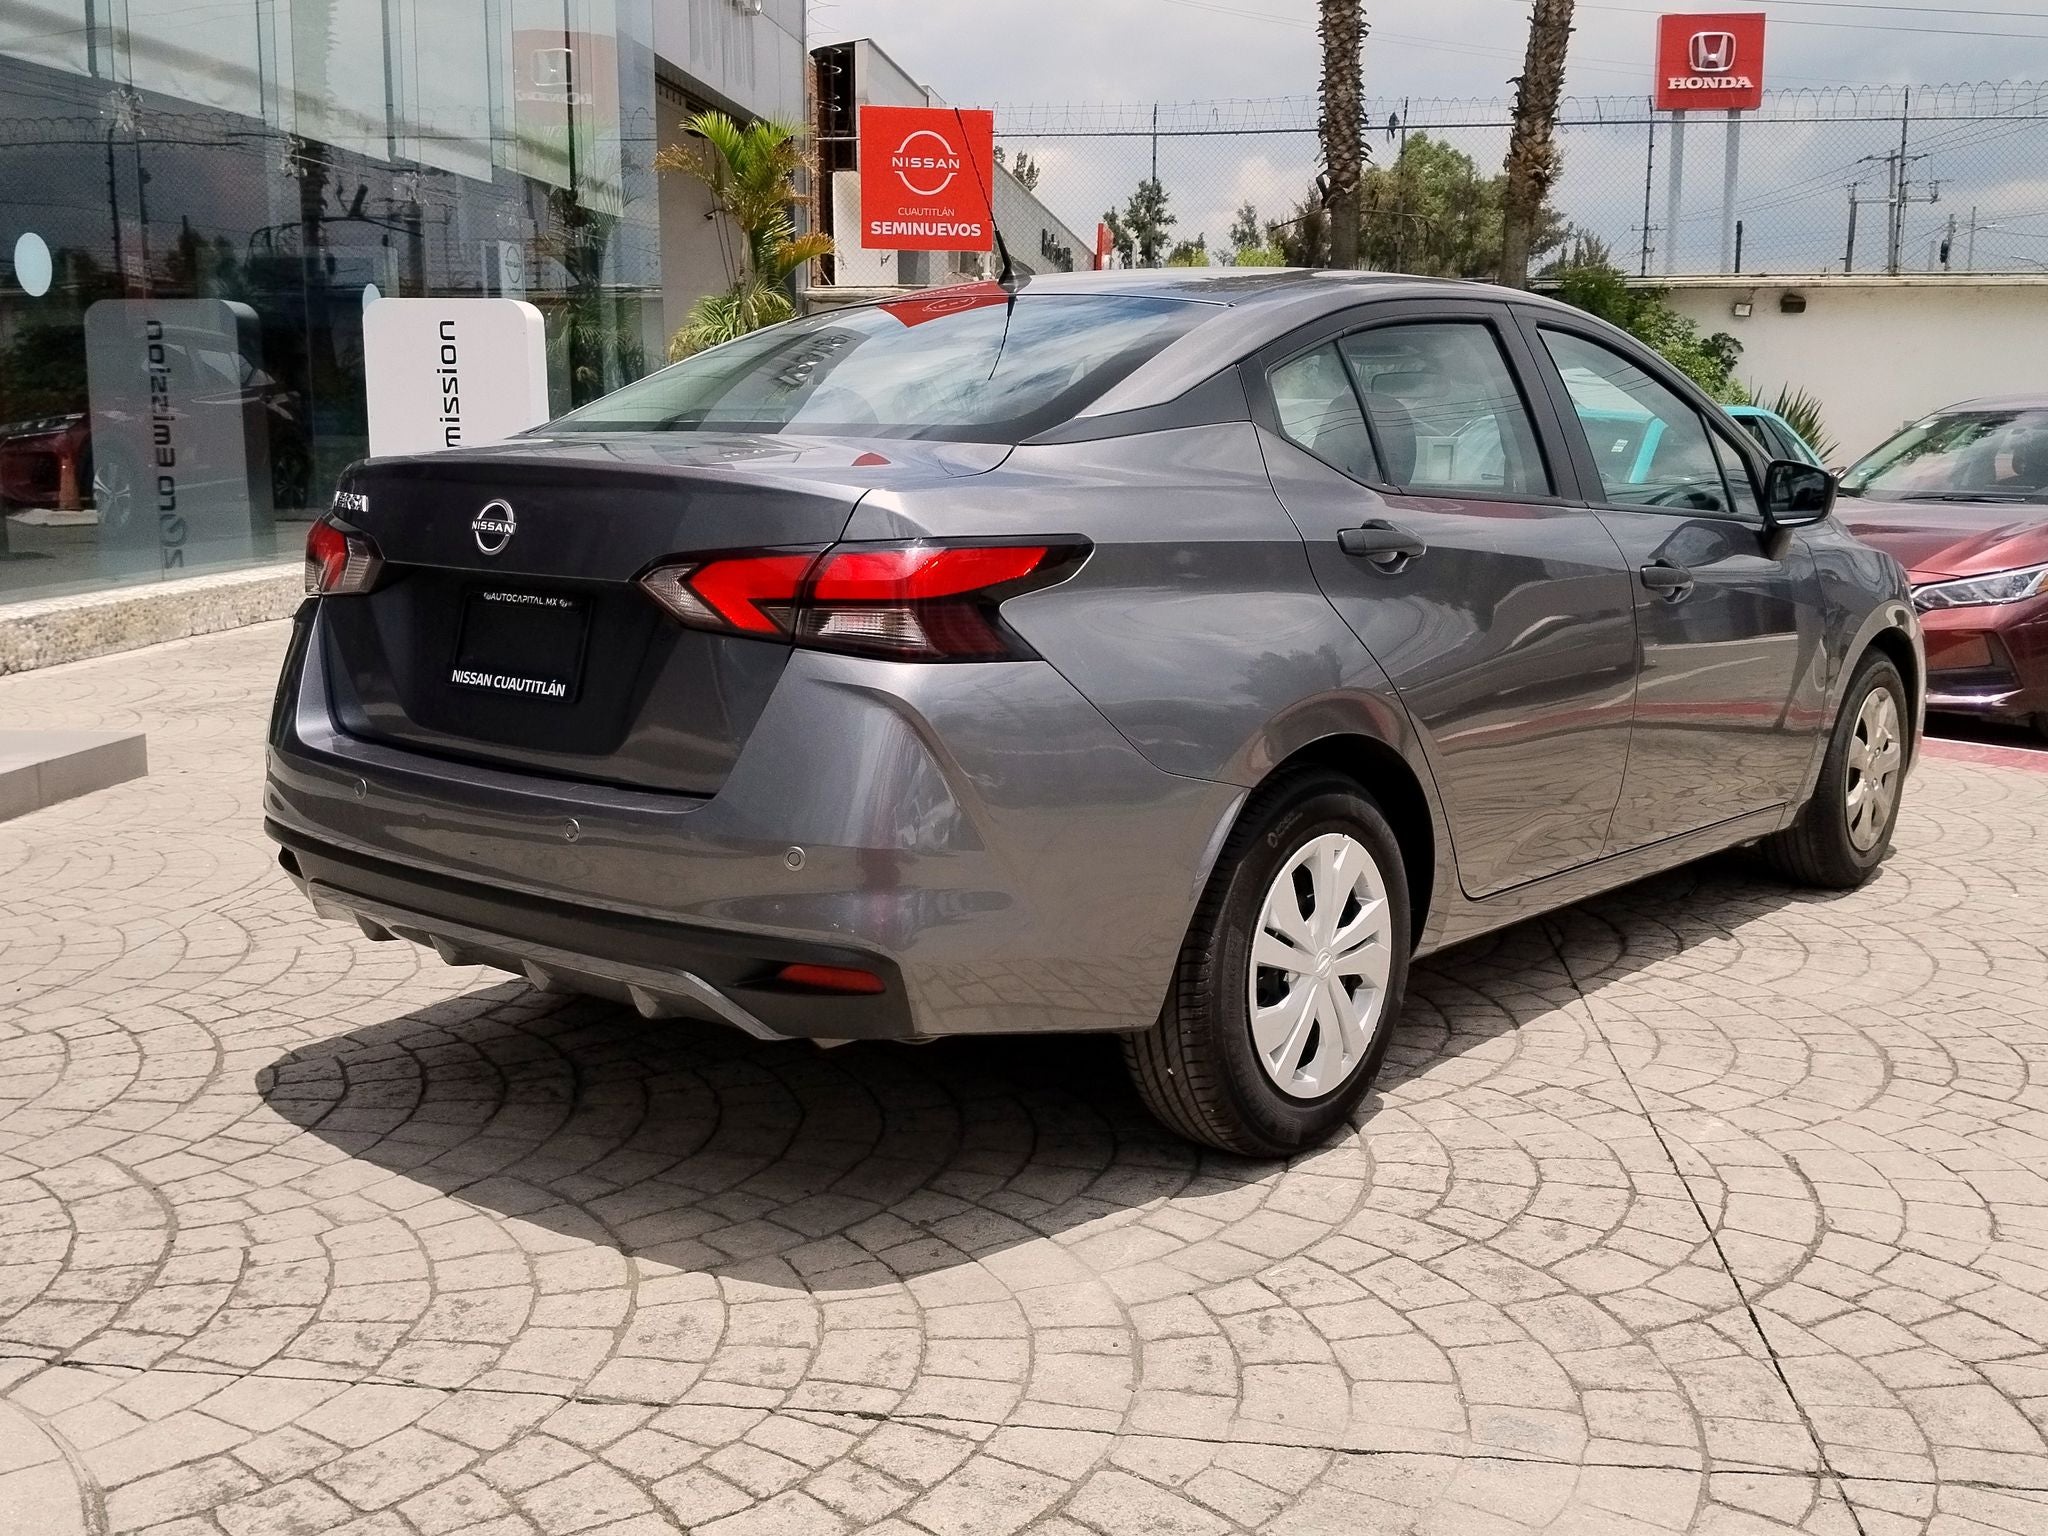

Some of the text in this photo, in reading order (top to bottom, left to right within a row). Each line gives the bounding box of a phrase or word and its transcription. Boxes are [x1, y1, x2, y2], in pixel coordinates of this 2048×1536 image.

[1667, 76, 1754, 90] HONDA
[892, 156, 960, 169] NISSAN
[897, 206, 955, 217] CUAUTITLÁN
[870, 220, 982, 237] SEMINUEVOS
[471, 520, 515, 534] NISSAN
[451, 669, 566, 697] NISSAN CUAUTITLÁN
